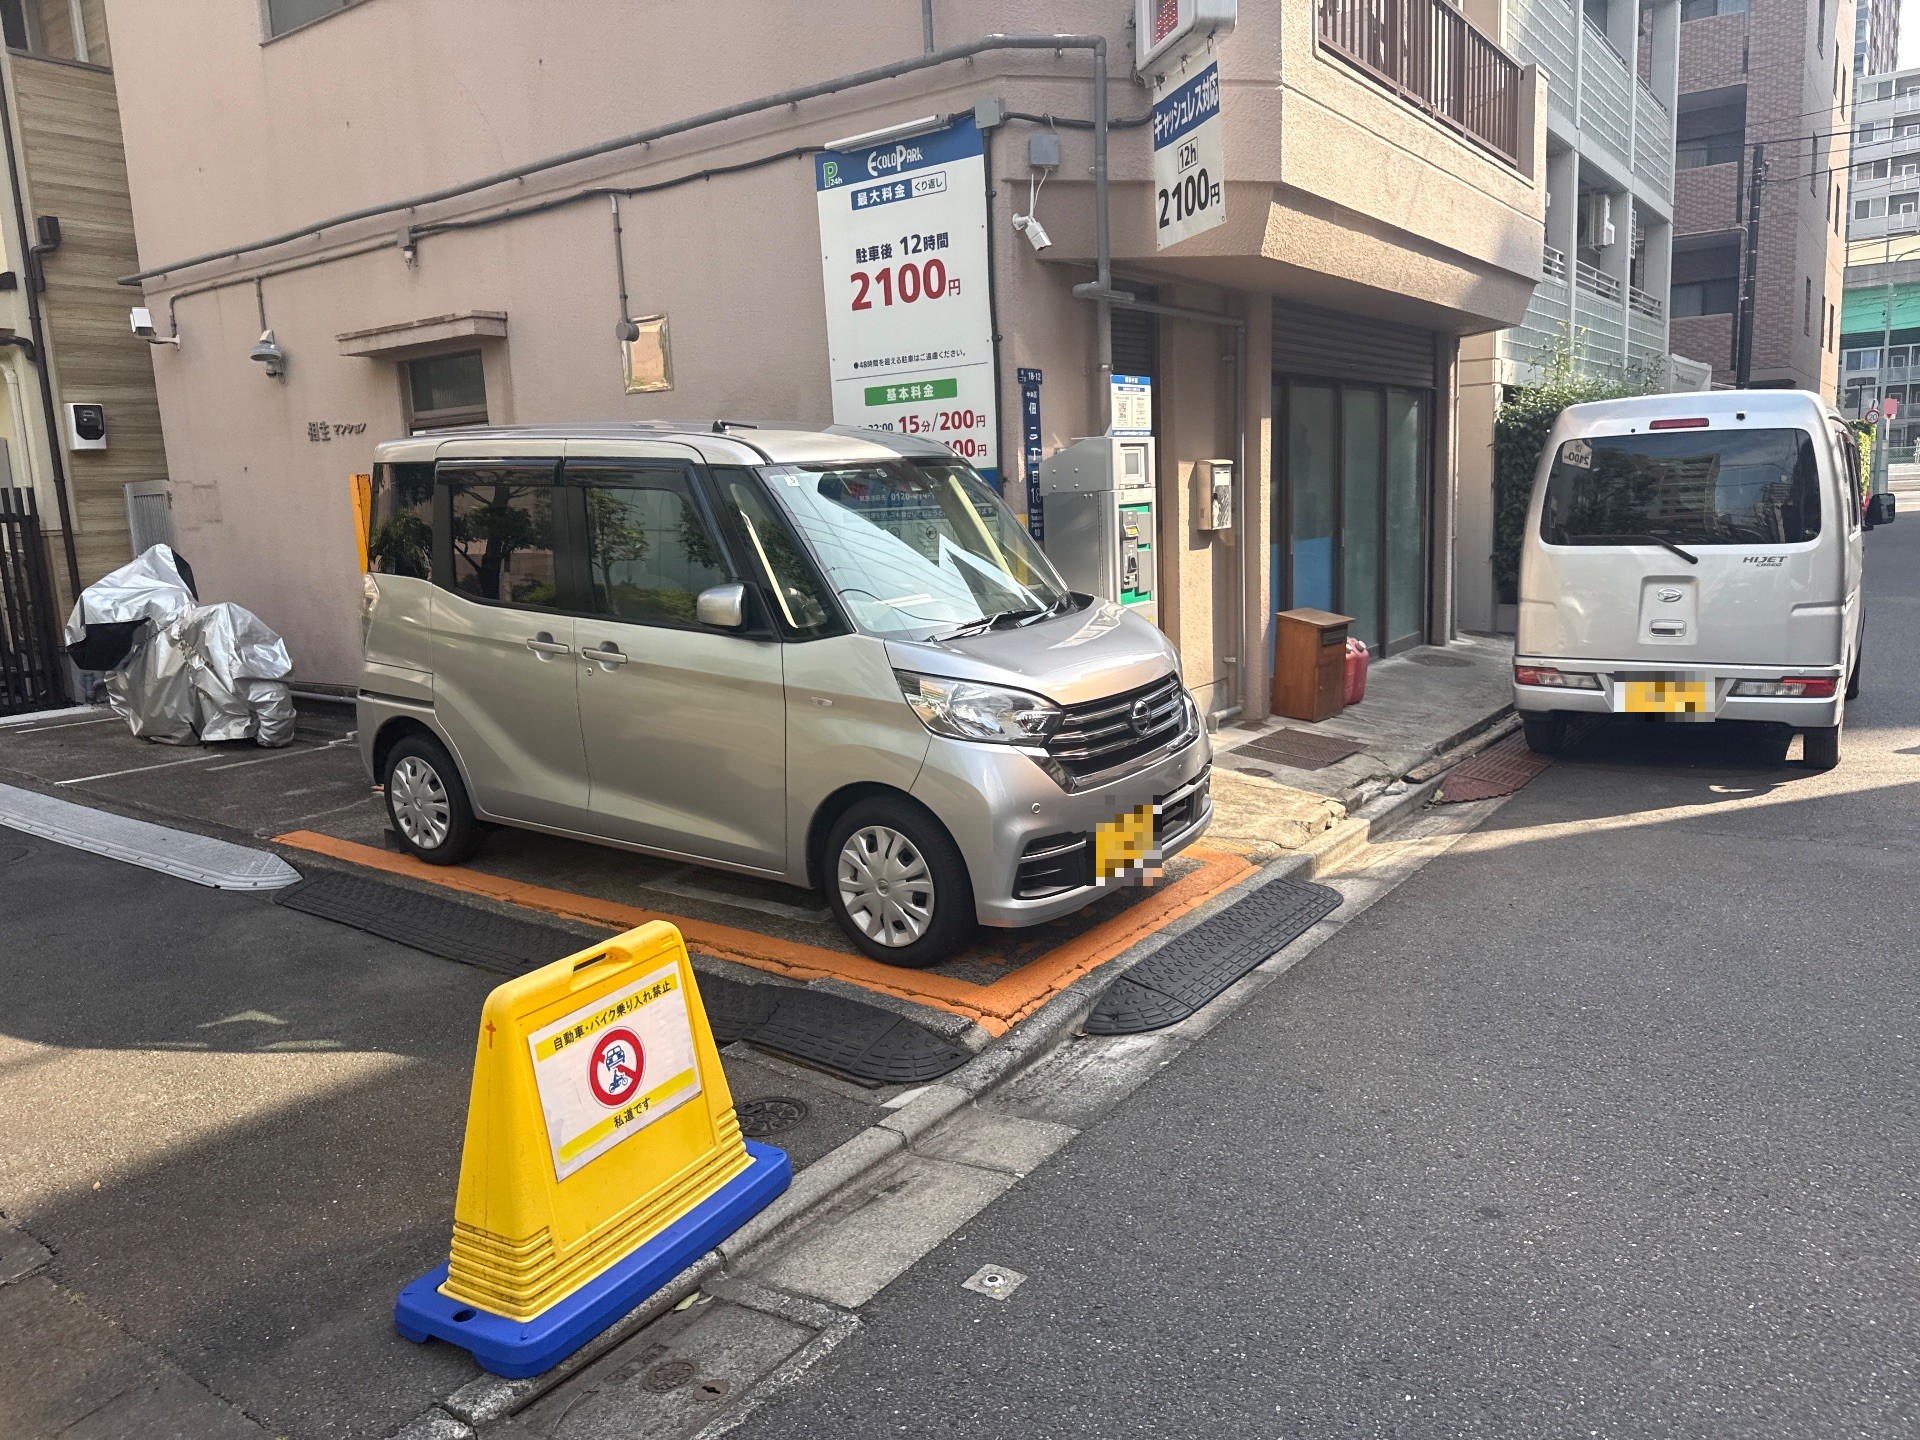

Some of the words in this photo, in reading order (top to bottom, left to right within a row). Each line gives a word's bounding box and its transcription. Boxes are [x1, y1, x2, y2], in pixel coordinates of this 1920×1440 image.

[1154, 70, 1218, 141] キャッシュレス対応
[1180, 142, 1197, 169] 12h
[857, 183, 906, 207] 最大料金
[914, 177, 943, 192] くり返し
[1158, 168, 1220, 229] 2100円
[855, 243, 893, 264] 駐車後
[899, 232, 949, 256] 12時間
[850, 258, 961, 311] 2100円
[886, 384, 934, 402] 基本料金
[944, 438, 987, 458] 00円
[553, 980, 672, 1051] 自動車・バイク乗り入れ禁止
[613, 1098, 651, 1129] 私道です
